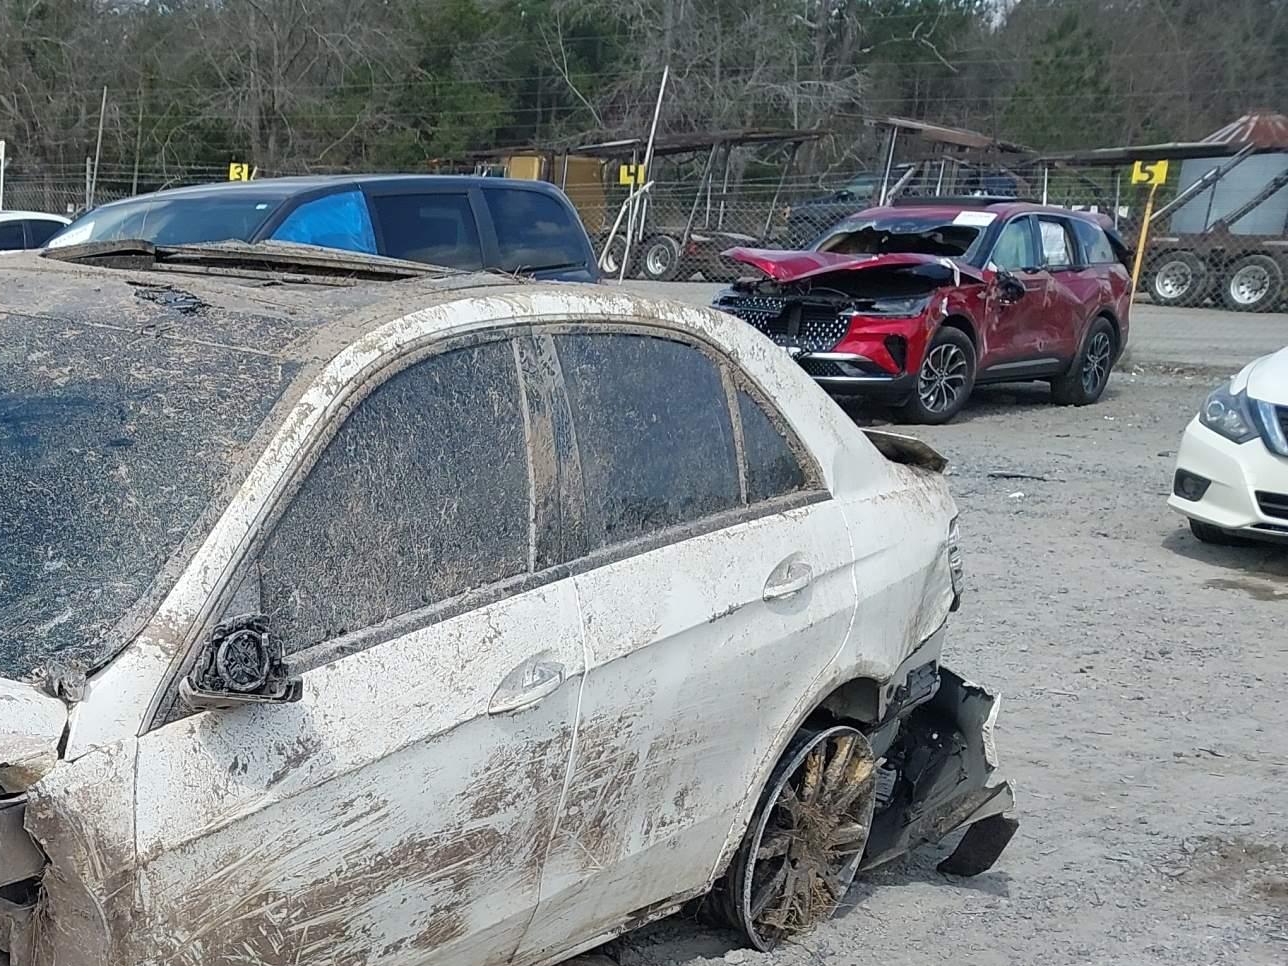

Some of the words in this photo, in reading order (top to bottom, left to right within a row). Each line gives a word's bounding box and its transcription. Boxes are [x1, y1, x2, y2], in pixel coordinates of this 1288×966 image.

[234, 164, 244, 180] 3
[626, 164, 639, 184] 4
[1137, 160, 1158, 183] 5
